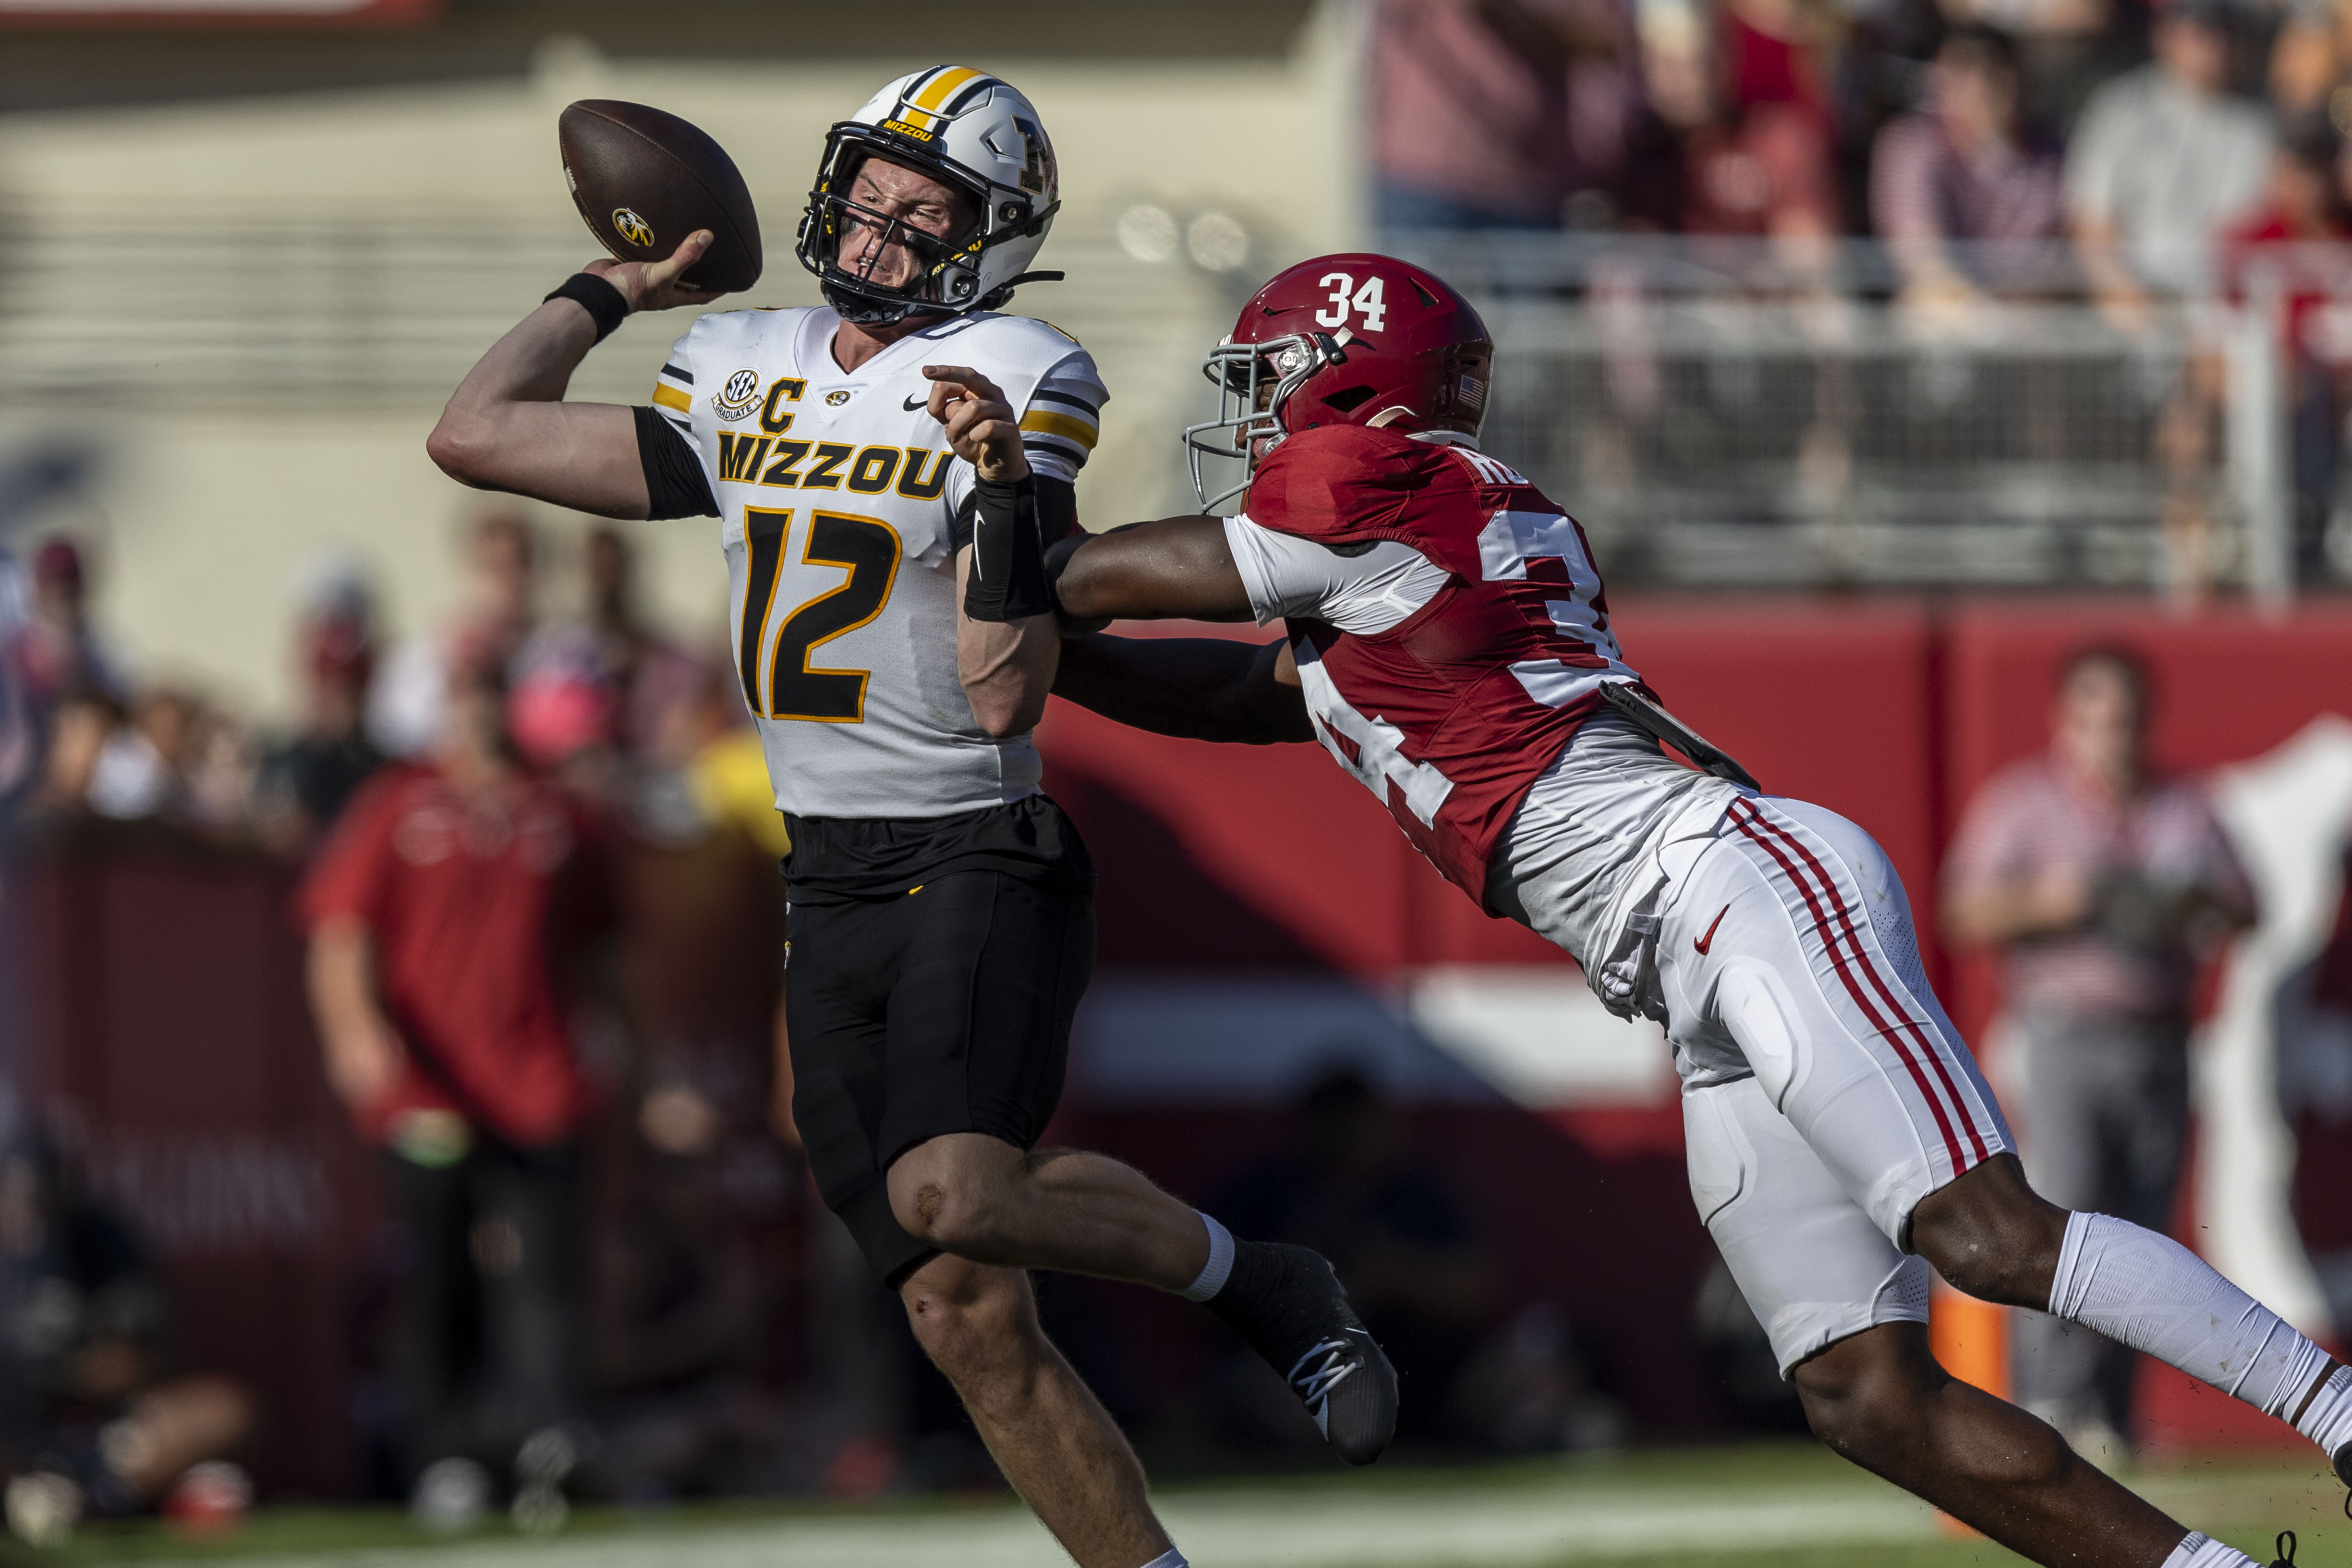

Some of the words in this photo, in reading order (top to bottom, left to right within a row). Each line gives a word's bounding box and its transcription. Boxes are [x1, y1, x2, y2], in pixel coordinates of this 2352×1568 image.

[883, 120, 933, 142] MIZZOU
[1315, 272, 1386, 332] 34
[715, 404, 753, 419] GRADUATE
[726, 371, 757, 401] SEC
[758, 377, 807, 437] C
[717, 430, 955, 501] MIZZOU
[740, 505, 902, 724] 12
[1477, 510, 1639, 708] 3
